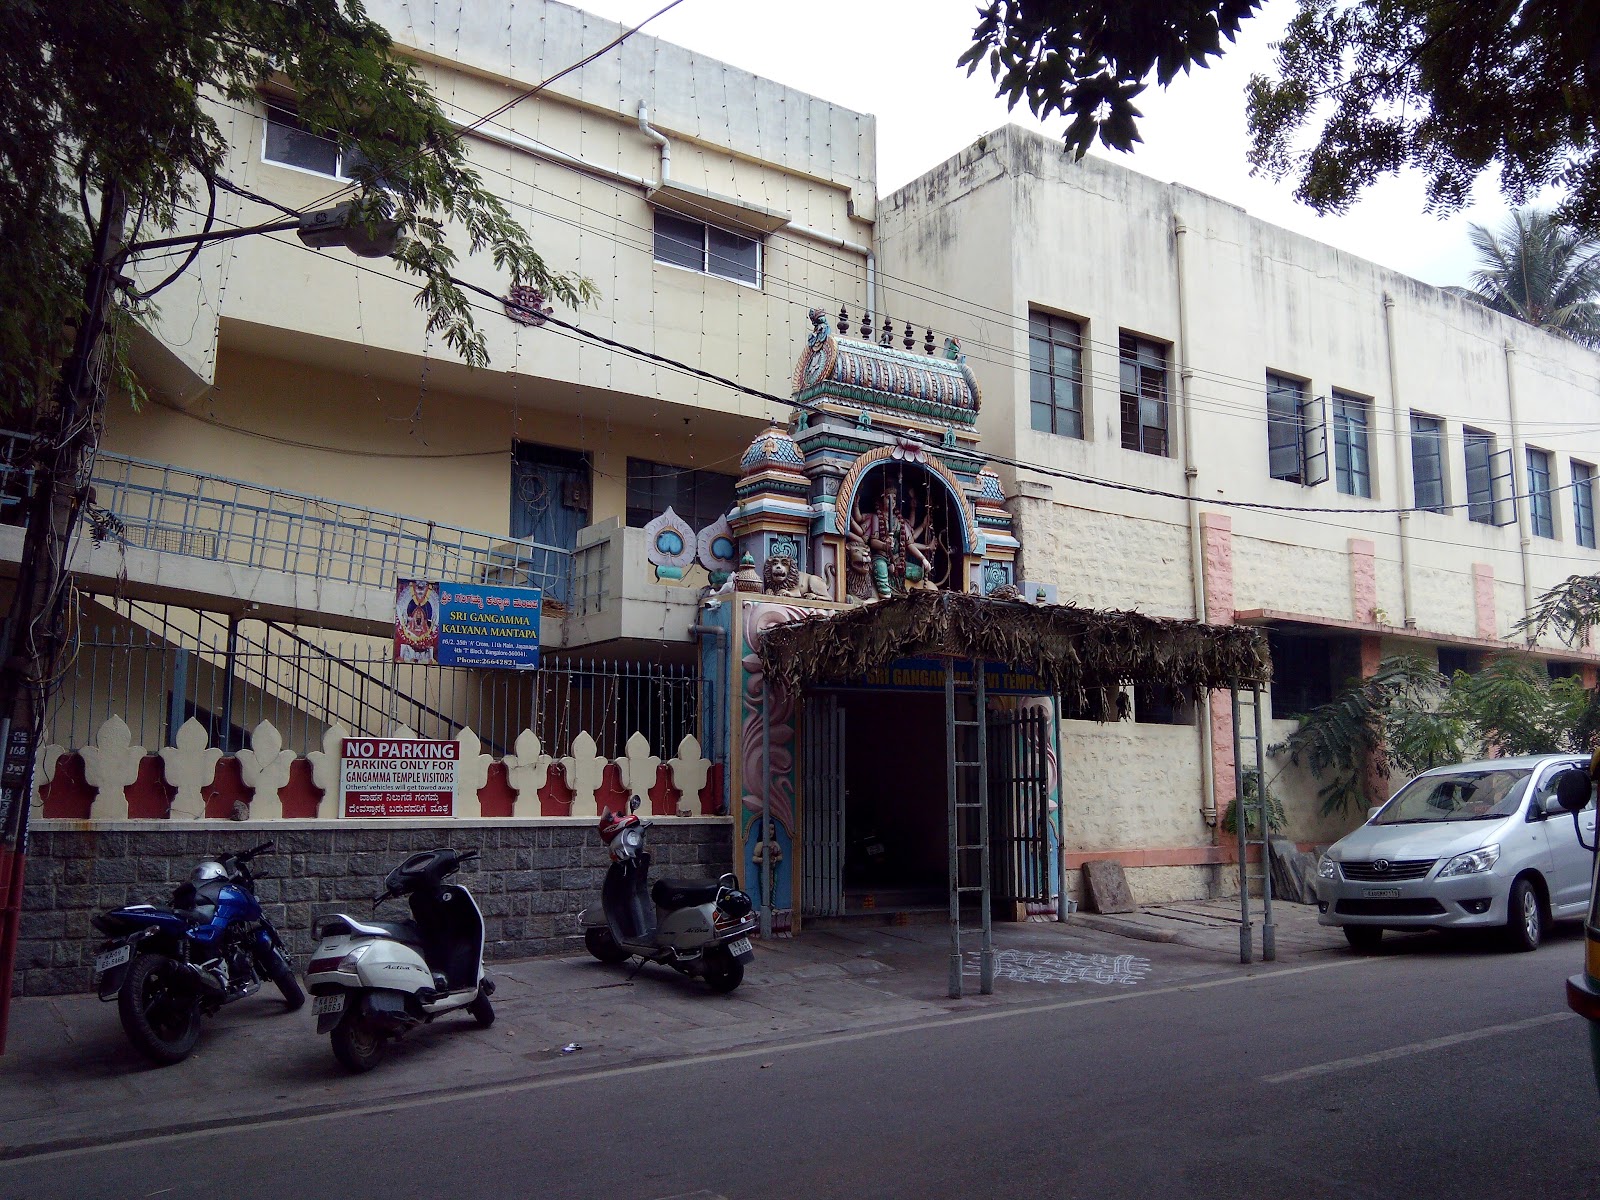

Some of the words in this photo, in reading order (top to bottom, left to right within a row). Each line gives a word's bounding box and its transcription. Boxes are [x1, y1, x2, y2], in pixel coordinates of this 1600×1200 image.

[450, 611, 467, 621] SRI
[470, 613, 531, 626] GANGAMMA
[442, 624, 488, 637] KALYANA
[490, 628, 538, 639] MANTAPA
[346, 742, 375, 757] NO
[378, 742, 455, 759] PARKING
[346, 760, 397, 770] PARKING
[400, 760, 429, 770] ONLY
[432, 761, 454, 770] FOR
[346, 771, 391, 783] GANGAMMA
[393, 772, 420, 783] TEMPLE
[421, 772, 454, 783] VISITORS
